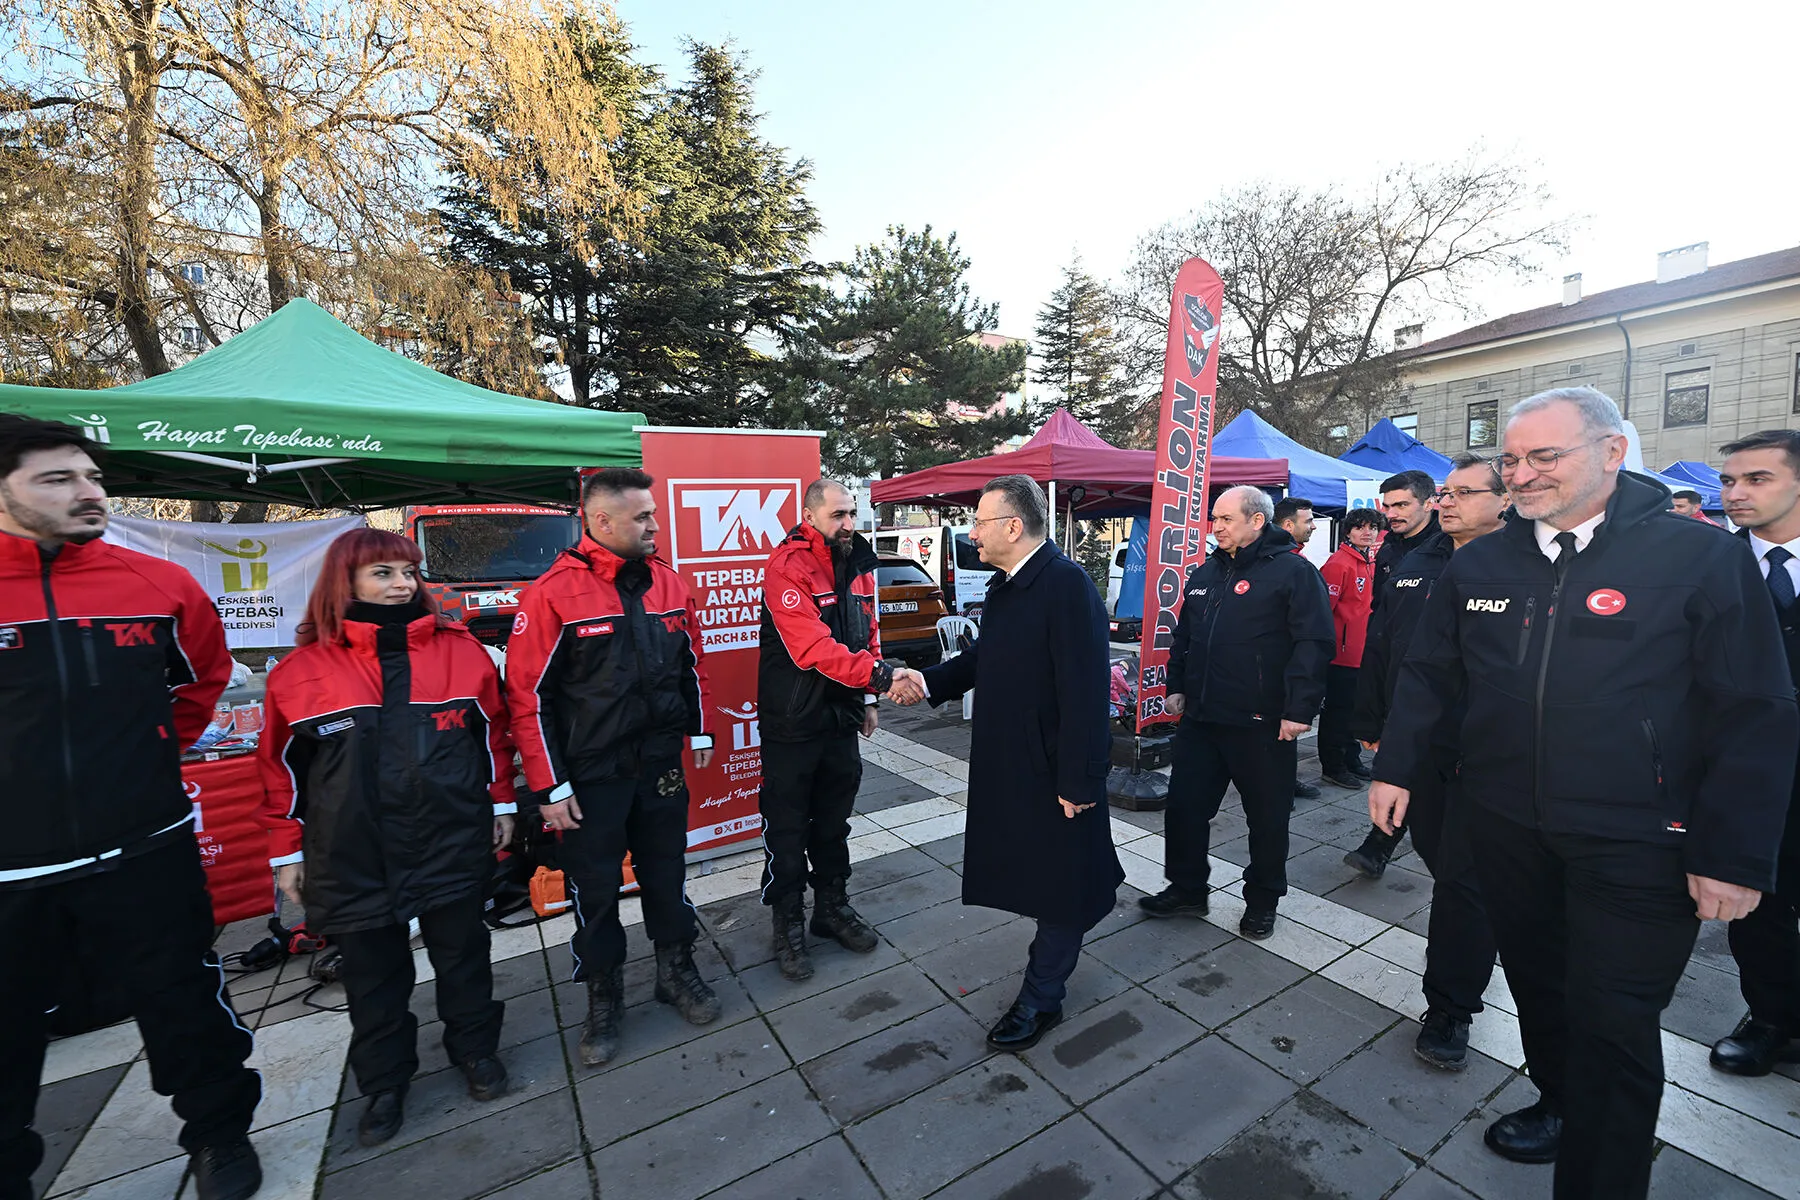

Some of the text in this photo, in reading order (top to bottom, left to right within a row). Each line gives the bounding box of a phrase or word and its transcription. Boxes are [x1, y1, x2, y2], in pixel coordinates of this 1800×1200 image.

[1187, 344, 1204, 367] DAK
[137, 420, 227, 448] Hayat
[1190, 395, 1212, 522] KURTARMA
[681, 489, 792, 552] TAK
[1187, 527, 1200, 556] VE
[693, 567, 765, 588] TEPEBA
[1397, 578, 1423, 588] AFAD
[217, 595, 275, 606] ESKİŞEHİR
[470, 591, 520, 607] TAK
[705, 586, 762, 607] ARAM
[1466, 598, 1510, 613] AFAD
[104, 622, 158, 647] TAK
[740, 631, 749, 642] &
[431, 709, 468, 731] TAK
[721, 758, 762, 775] TEPEBA
[700, 791, 732, 809] Hayat
